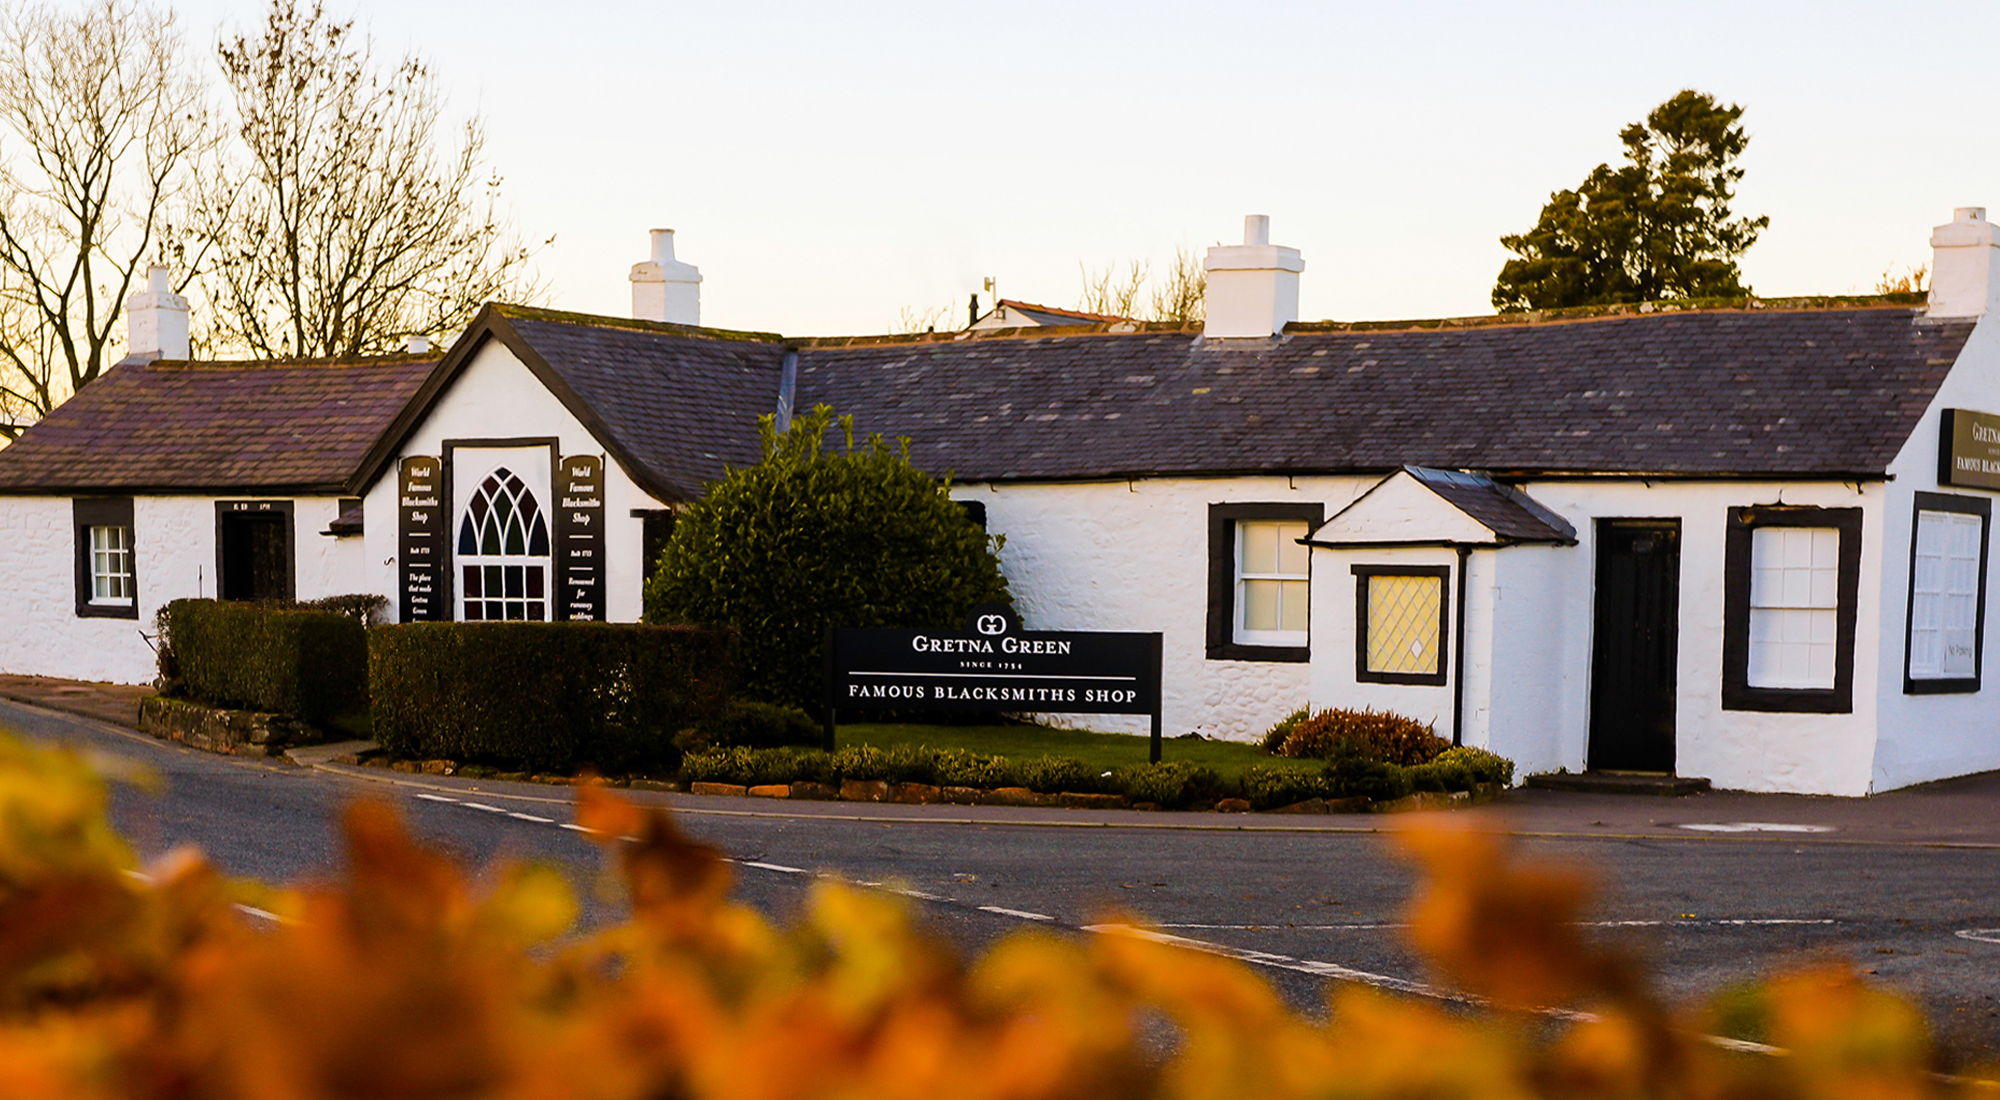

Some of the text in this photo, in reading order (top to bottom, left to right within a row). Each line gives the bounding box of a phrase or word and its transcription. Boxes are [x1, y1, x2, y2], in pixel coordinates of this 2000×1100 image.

[1957, 456, 1981, 472] FAMOUS
[410, 466, 431, 477] World
[571, 466, 592, 477] World
[407, 481, 432, 492] Famous
[569, 482, 595, 493] Famous
[401, 496, 439, 507] Blacksmiths
[561, 497, 601, 508] Blacksmiths
[411, 511, 429, 525] Shop
[572, 512, 591, 526] Shop
[409, 573, 432, 584] The place
[568, 576, 595, 586] Renowned
[408, 584, 432, 593] that made
[576, 588, 586, 600] for
[411, 595, 429, 604] Gretna
[412, 606, 428, 615] Green
[912, 635, 1071, 655] GRETNA GREEN
[960, 661, 992, 669] SINCE
[849, 685, 1137, 703] FAMOUS BLACKSMITHS SHOP
